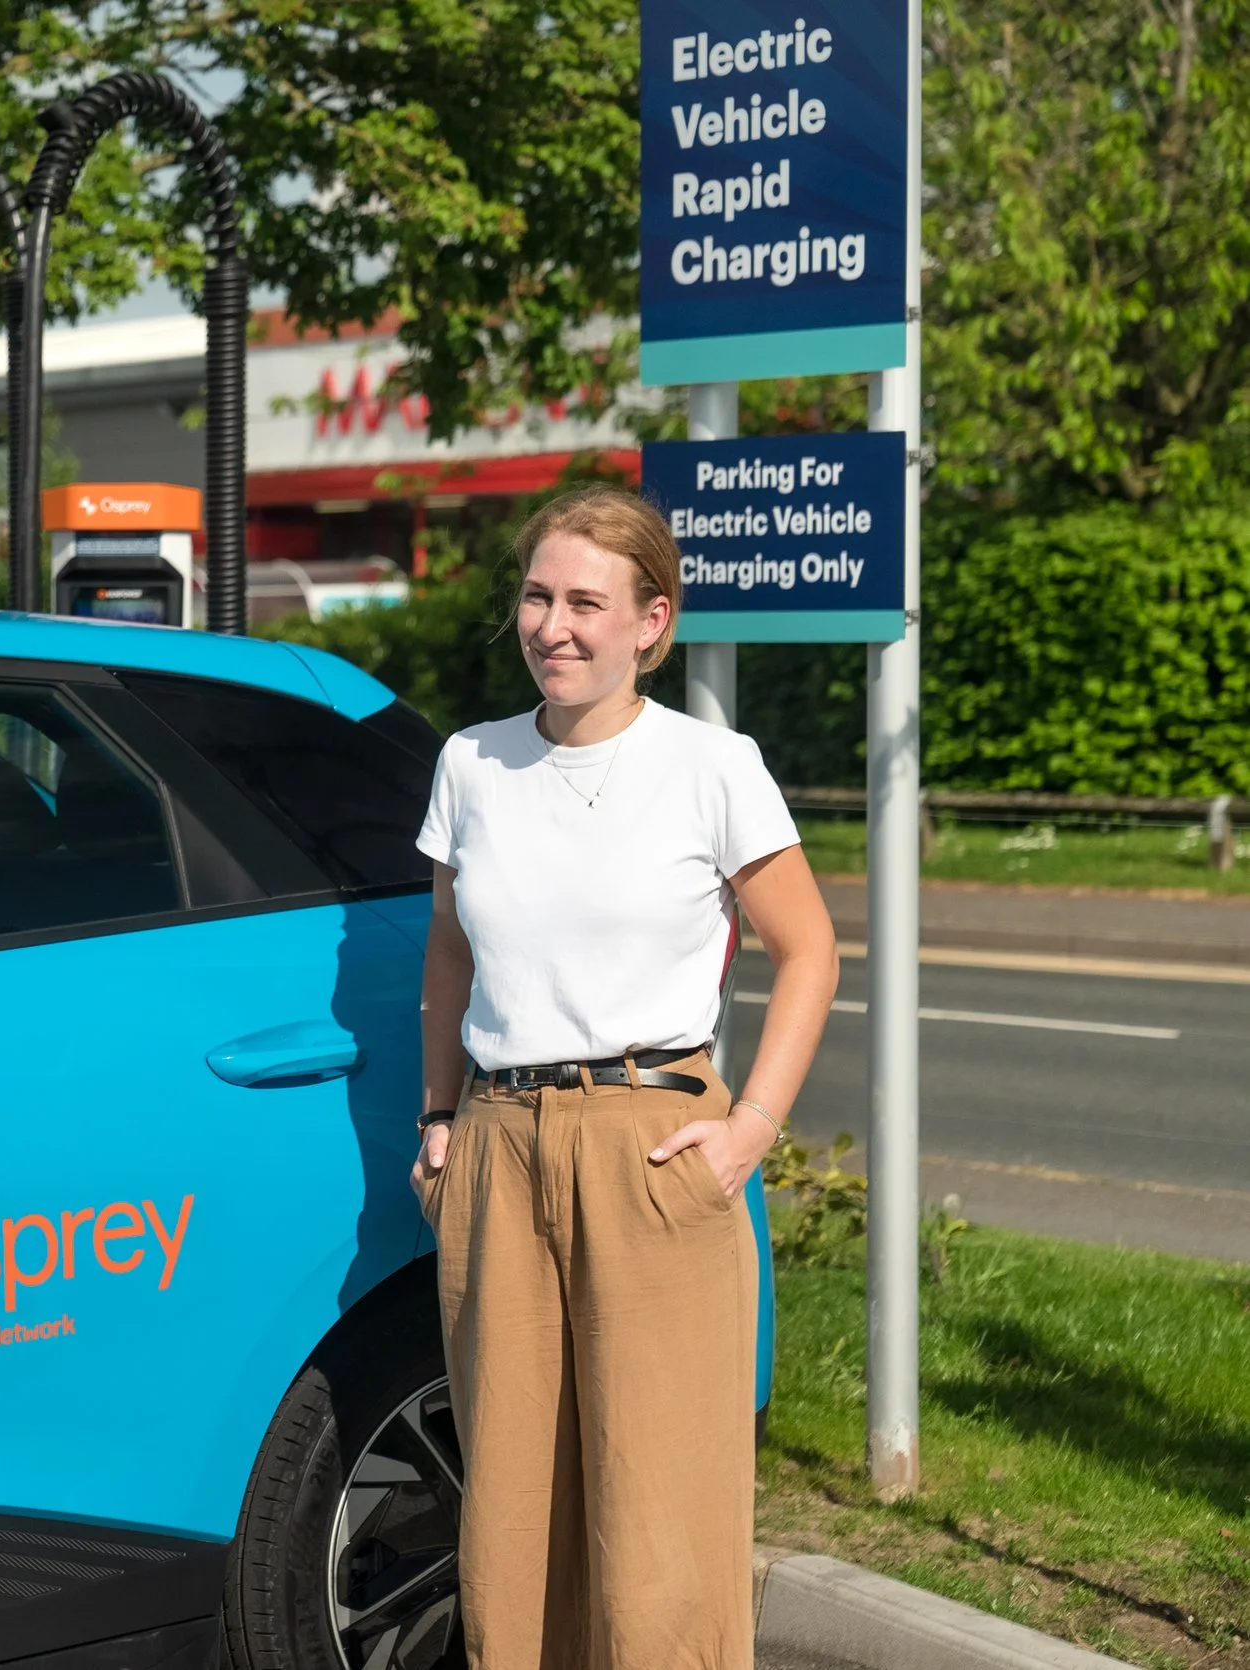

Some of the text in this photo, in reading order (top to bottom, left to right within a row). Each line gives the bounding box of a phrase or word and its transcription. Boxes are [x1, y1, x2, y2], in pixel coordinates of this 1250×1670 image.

[672, 18, 833, 82] Electric
[671, 88, 826, 149] Vehicle
[672, 158, 790, 222] Rapid
[671, 226, 866, 287] Charging
[697, 456, 844, 494] Parking For
[100, 496, 152, 515] Osprey
[671, 502, 872, 538] Electric Vehicle
[679, 550, 864, 590] Charging Only
